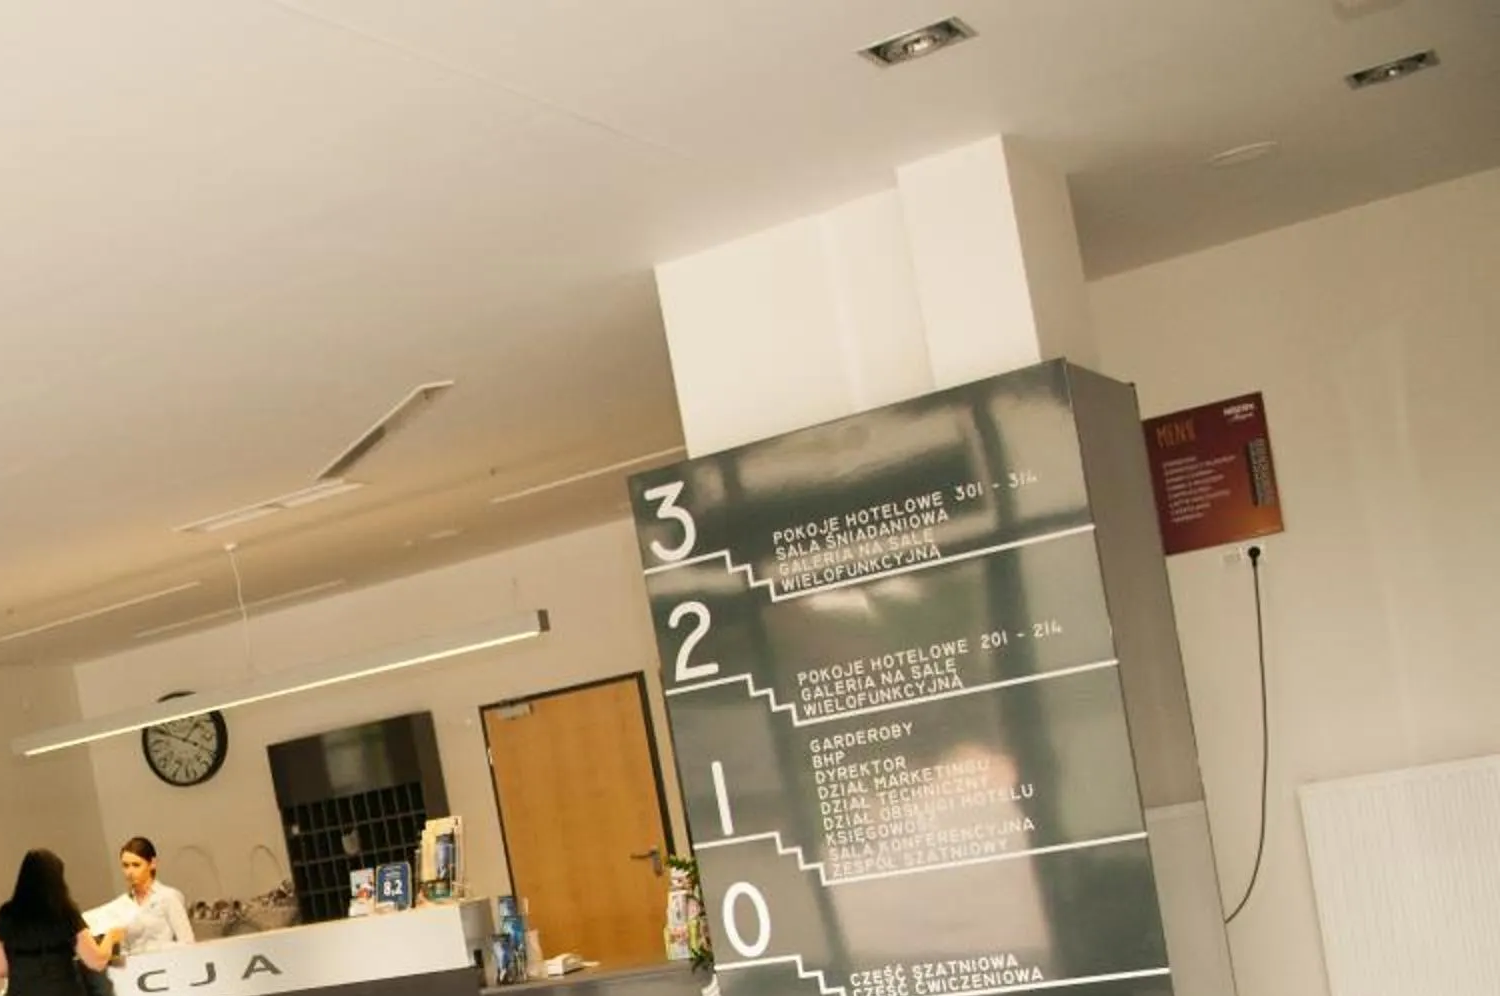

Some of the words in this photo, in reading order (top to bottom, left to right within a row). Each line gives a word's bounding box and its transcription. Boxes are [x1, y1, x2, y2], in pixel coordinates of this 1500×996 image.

[644, 480, 696, 562] 3
[773, 517, 840, 545] POKOJE
[845, 491, 943, 527] HOTELOWE
[955, 480, 984, 501] 301
[775, 540, 821, 562] SALA
[779, 547, 852, 576] GALERIA
[858, 540, 884, 557] NA
[668, 601, 719, 682] 2
[796, 660, 865, 686] POKOJE
[870, 639, 969, 670] HOTELOWE
[980, 630, 1008, 649] 201
[1032, 619, 1062, 638] 214
[800, 677, 875, 702] GALERIA
[881, 670, 906, 686] NA
[809, 721, 914, 753] GARDEROBY
[812, 751, 846, 769] BHP
[814, 756, 907, 785] DYREKTOR
[828, 841, 874, 861] SALA
[722, 881, 771, 958] 0
[912, 952, 1018, 979] SZATNIOWA
